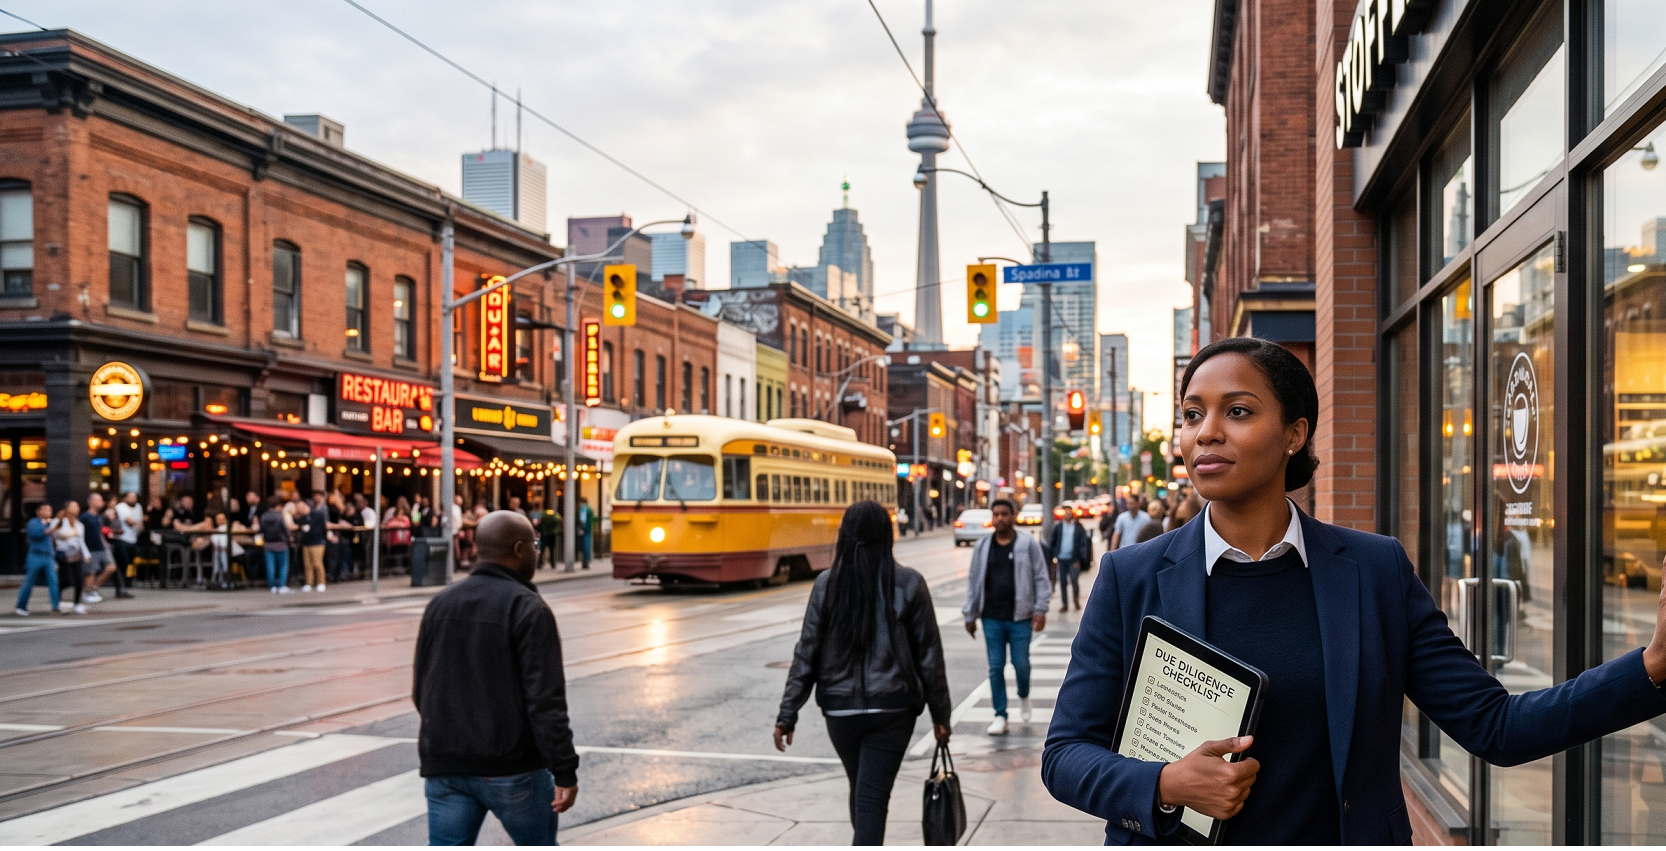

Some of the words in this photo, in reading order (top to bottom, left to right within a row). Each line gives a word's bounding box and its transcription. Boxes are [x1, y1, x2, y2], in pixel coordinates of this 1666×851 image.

[1011, 266, 1061, 281] Spadina
[372, 406, 404, 433] BAR
[1155, 648, 1177, 666] DUE
[1178, 660, 1235, 699] DILIGENCE
[1162, 665, 1221, 702] CHECKLIST
